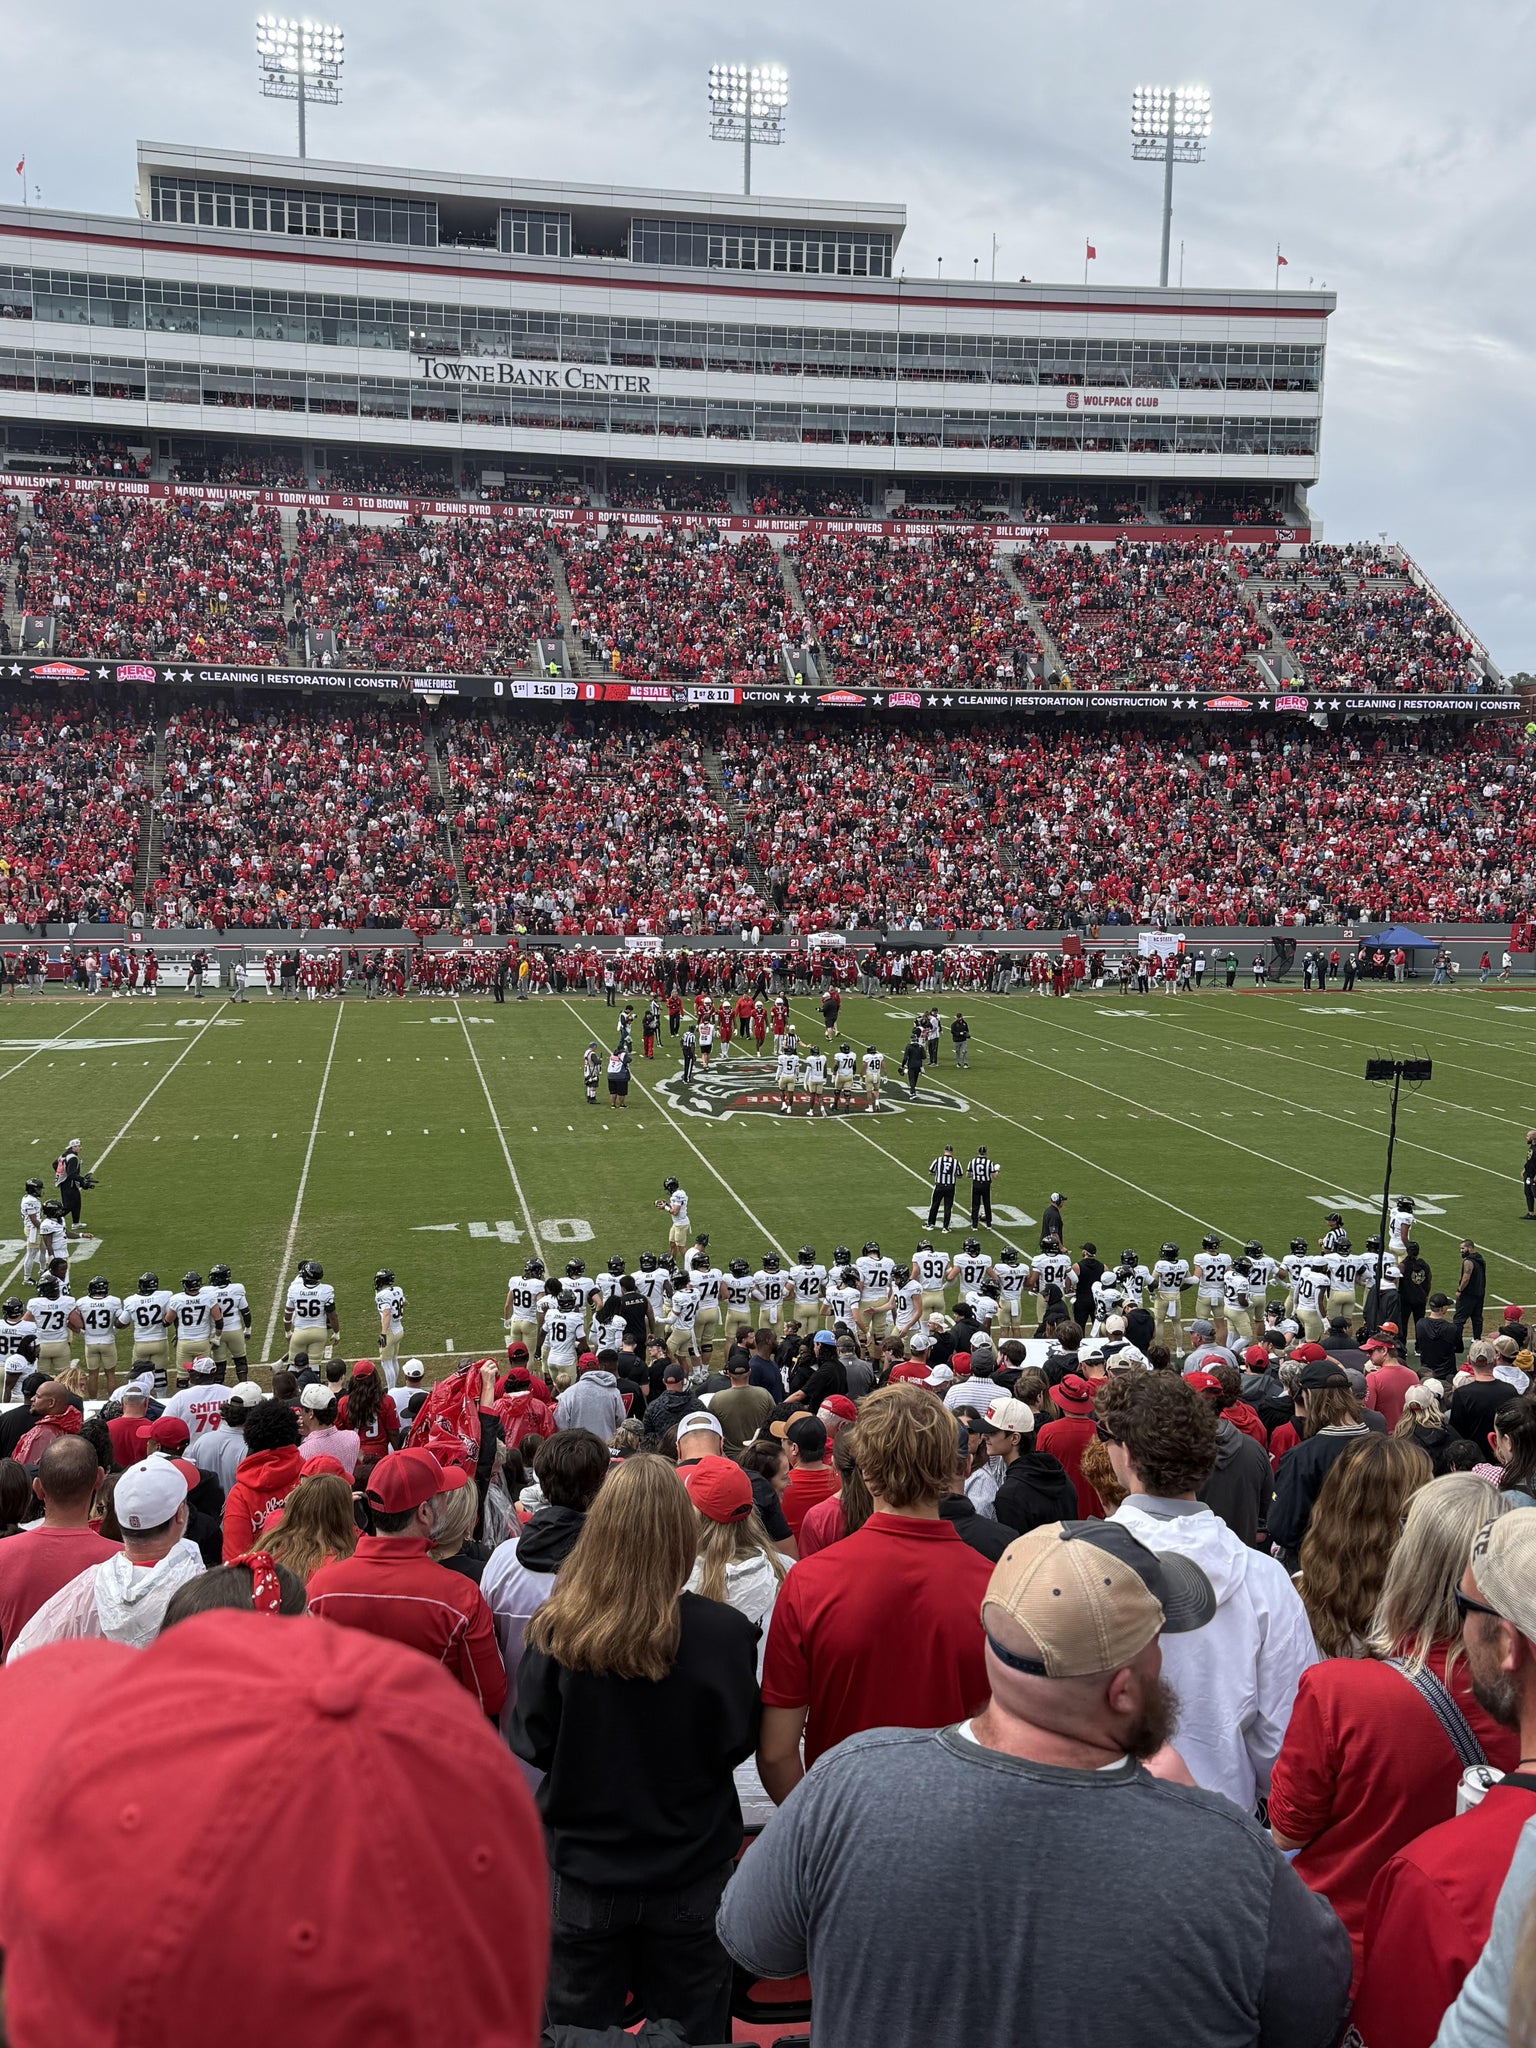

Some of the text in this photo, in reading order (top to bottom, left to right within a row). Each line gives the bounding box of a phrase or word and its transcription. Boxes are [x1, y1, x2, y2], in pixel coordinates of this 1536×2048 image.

[1083, 395, 1159, 408] WOLFPACK CLUB
[75, 480, 116, 492] BRAEY
[118, 482, 149, 495] CHUBB
[175, 487, 204, 498] MARIO
[206, 488, 253, 501] WILLIAMS
[265, 492, 330, 506] 81 TORRY HOLT
[343, 497, 409, 511] 23 TED BROWN
[421, 502, 491, 515] 77 DENNIS BYRD
[503, 507, 574, 520] 40 DK CRISTY
[586, 511, 594, 521] 18
[629, 513, 658, 524] GABRIE
[742, 519, 803, 531] 51 JIM RITCHE
[827, 522, 853, 532] PHILIP
[855, 523, 882, 533] RIVERS
[893, 524, 901, 534] 16
[997, 526, 1013, 536] BILL
[316, 633, 324, 641] 27
[42, 667, 77, 675] SERVPRO
[117, 665, 156, 678] HERO
[199, 671, 398, 689] CLEANING RESTORATION CONSTR
[414, 679, 456, 690] WAKE FOREST
[494, 681, 503, 696] 0
[533, 684, 556, 695] 1:50
[586, 684, 595, 699] 0
[630, 686, 669, 697] NC STATE
[707, 690, 715, 700] &
[717, 690, 729, 701] 10
[742, 691, 780, 701] UCTION
[889, 692, 921, 704] HERO
[958, 696, 1168, 707] CLEANING RESTORATION CONSTRUCTION
[1275, 697, 1308, 708] HERO
[1345, 700, 1521, 710] CLEANING RESTORATION CONSTR
[131, 933, 141, 942] 19
[1343, 930, 1353, 938] 23
[462, 938, 474, 947] 20
[790, 939, 799, 947] 21
[786, 1060, 793, 1071] 5
[815, 1061, 822, 1072] 11
[842, 1058, 854, 1069] 70
[869, 1059, 881, 1070] 48
[943, 1162, 951, 1173] F
[976, 1164, 984, 1175] C
[468, 1218, 595, 1244] 40
[923, 1260, 944, 1279] 93
[964, 1265, 985, 1283] 87
[1044, 1265, 1064, 1283] 84
[1205, 1265, 1226, 1282] 23
[1335, 1265, 1356, 1283] 40
[868, 1270, 888, 1287] 76
[1003, 1275, 1024, 1291] 27
[1163, 1271, 1185, 1288] 35
[1250, 1268, 1266, 1286] 21
[644, 1280, 655, 1298] 7
[699, 1280, 719, 1301] 74
[765, 1283, 780, 1300] 18
[799, 1277, 820, 1295] 42
[512, 1288, 532, 1308] 88
[728, 1287, 747, 1304] 25
[136, 1304, 162, 1327] 62
[181, 1305, 206, 1326] 67
[296, 1299, 322, 1318] 56
[832, 1300, 845, 1317] 17
[40, 1310, 65, 1330] 73
[86, 1309, 110, 1330] 43
[552, 1322, 567, 1342] 18
[195, 1413, 222, 1433] 79
